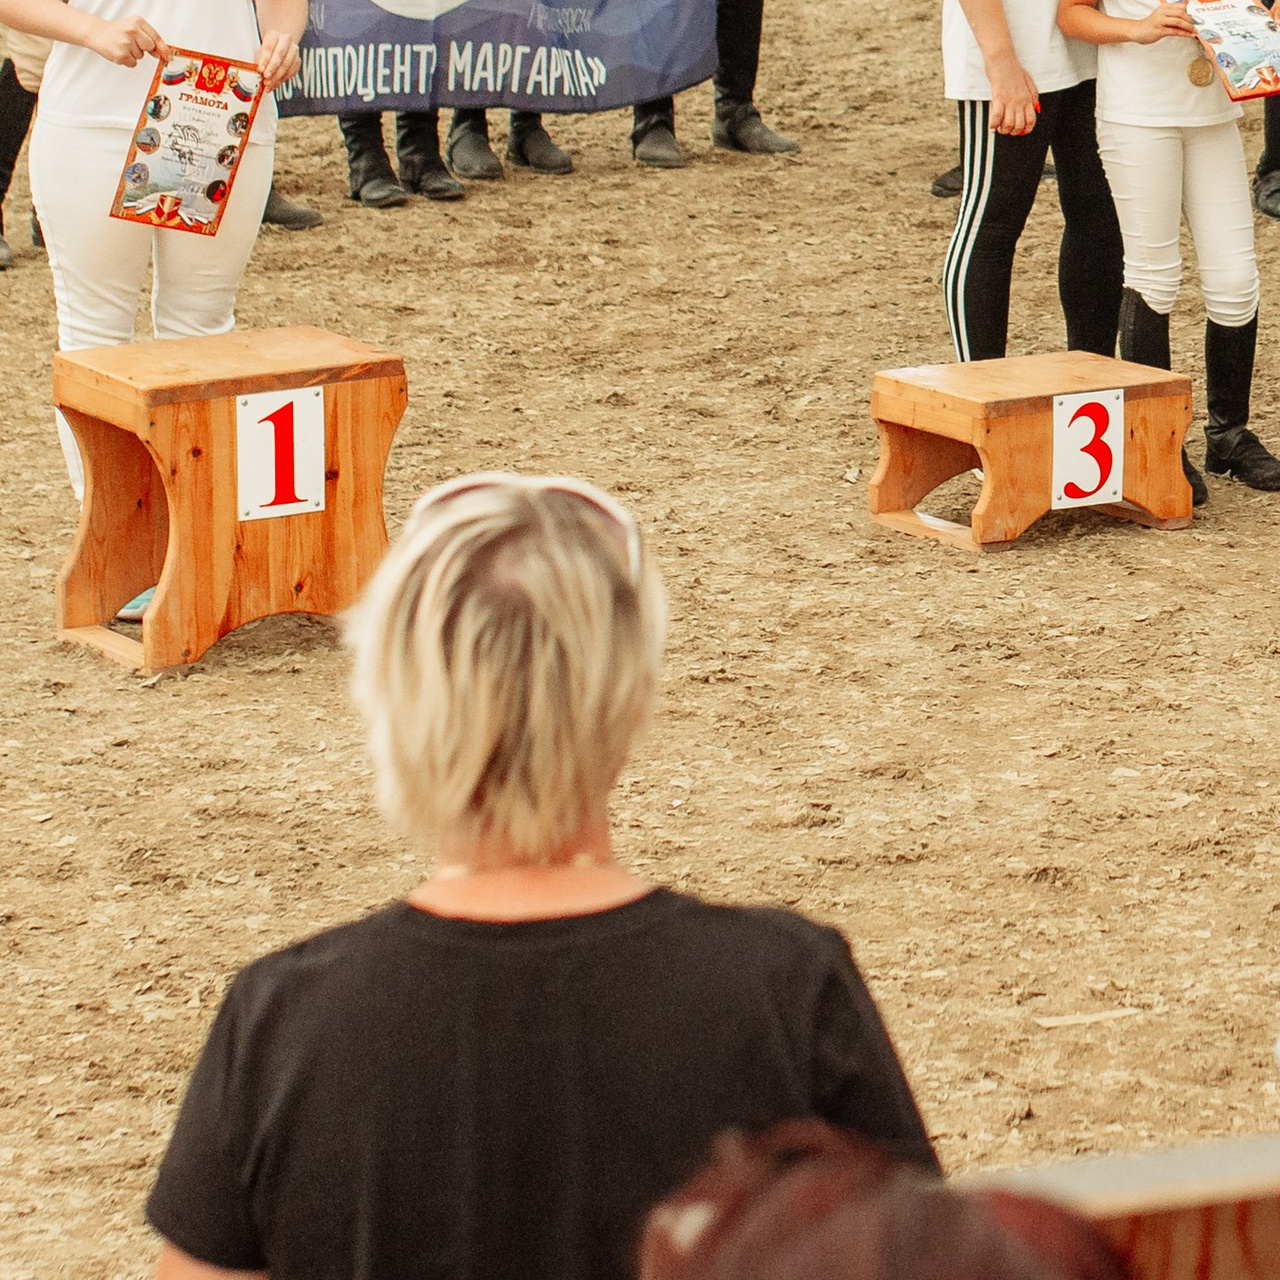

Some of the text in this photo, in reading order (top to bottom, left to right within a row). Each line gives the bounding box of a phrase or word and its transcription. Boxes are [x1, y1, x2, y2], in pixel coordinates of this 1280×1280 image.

[178, 92, 229, 111] ГРАМОТА
[257, 401, 308, 508] 1
[1064, 401, 1113, 499] 3
